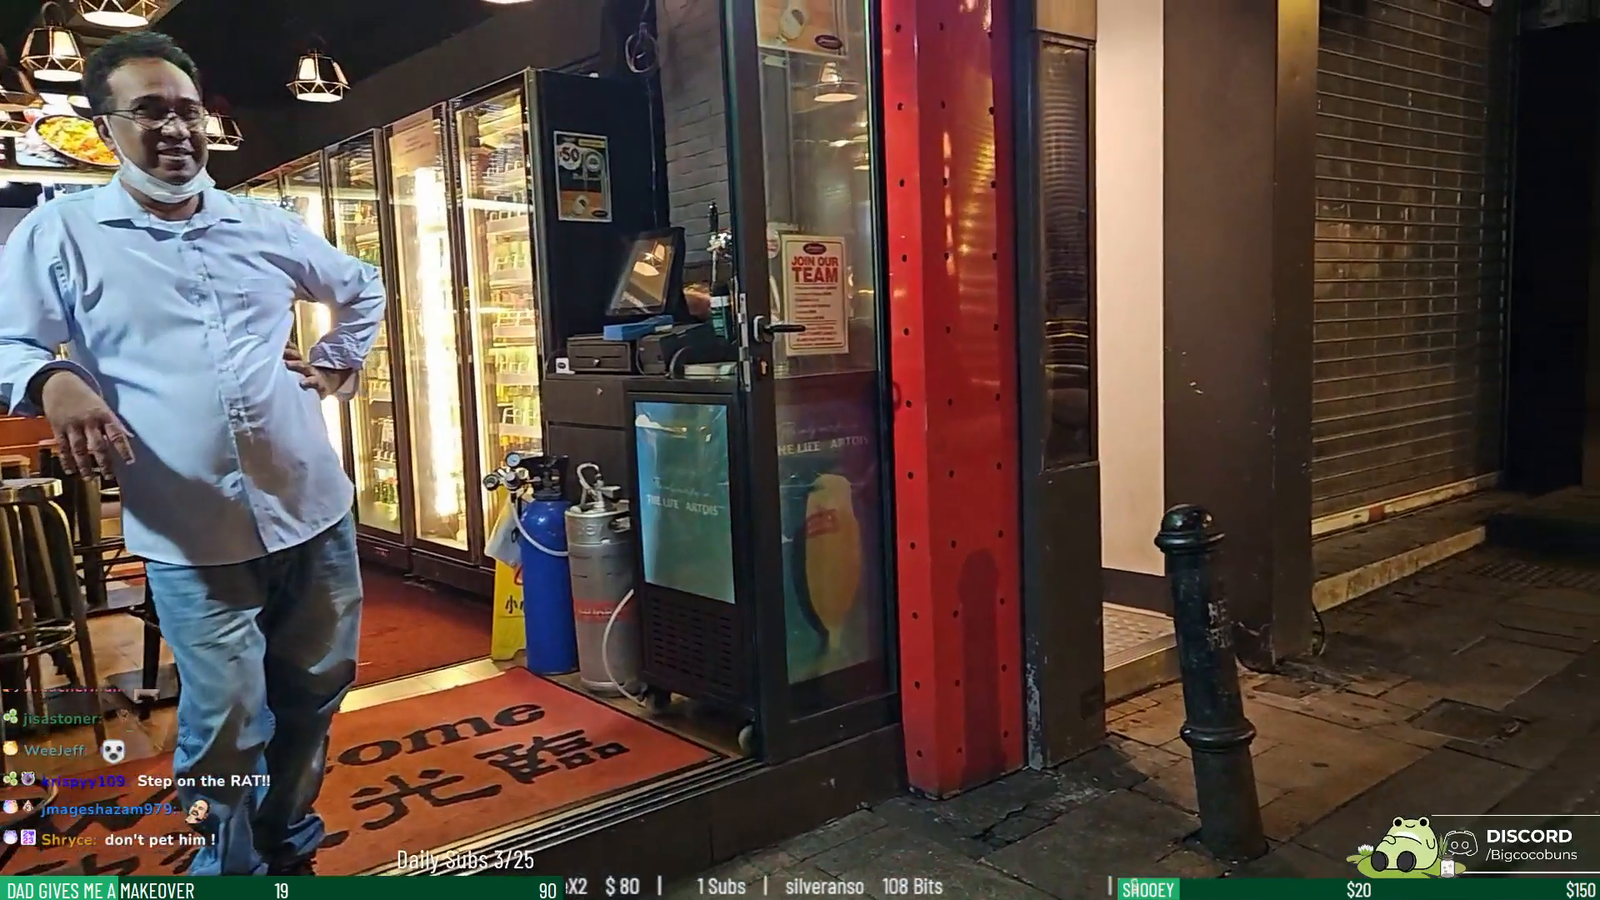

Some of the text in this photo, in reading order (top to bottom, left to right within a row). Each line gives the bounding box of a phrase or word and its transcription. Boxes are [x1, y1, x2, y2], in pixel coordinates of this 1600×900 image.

[791, 256, 839, 266] JOIN OUR
[791, 267, 838, 282] TEAM
